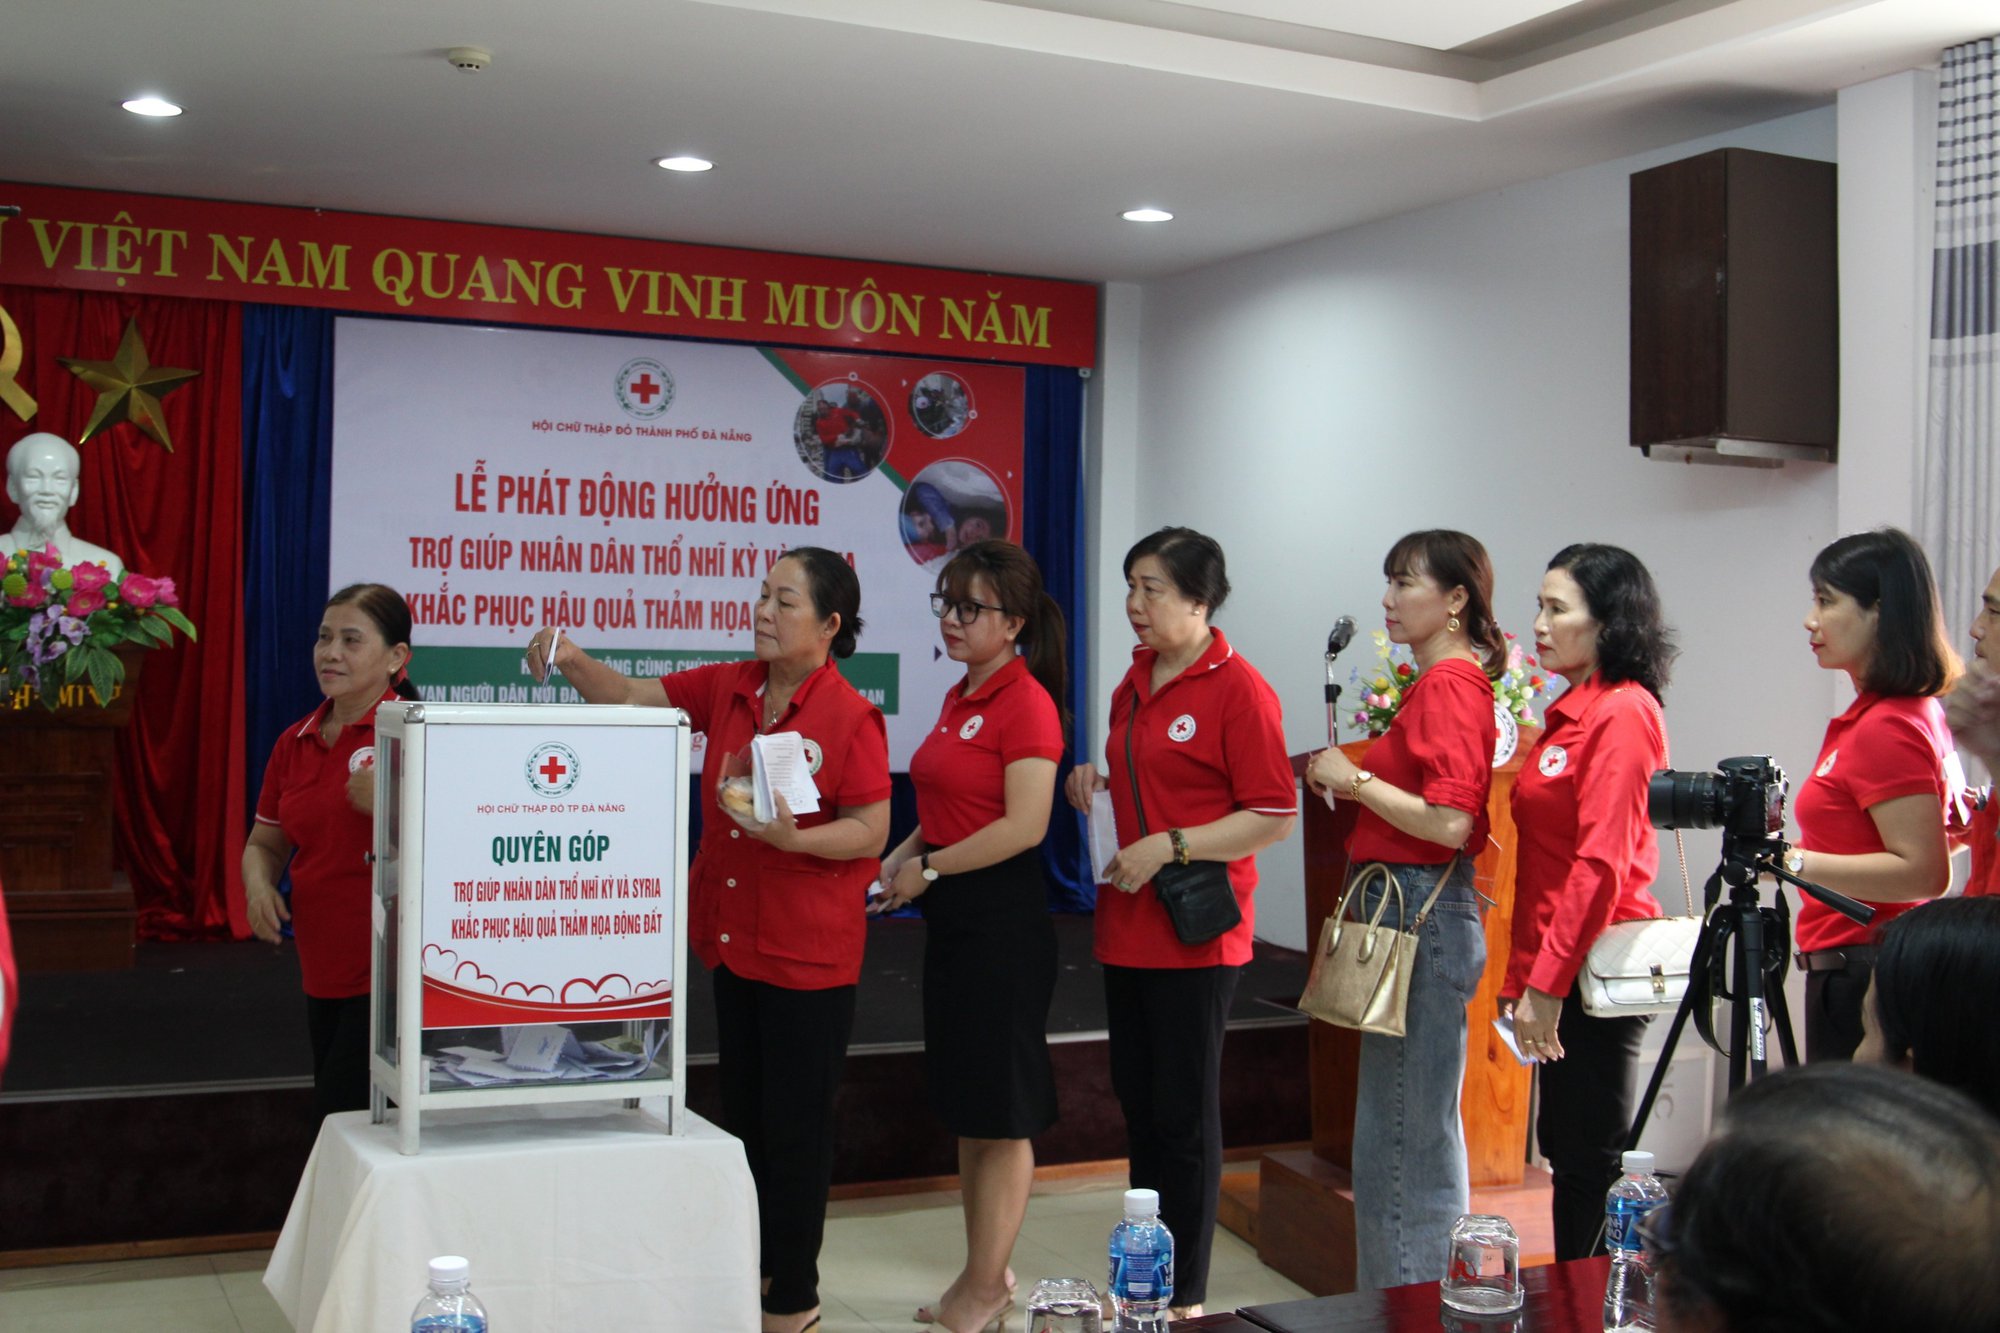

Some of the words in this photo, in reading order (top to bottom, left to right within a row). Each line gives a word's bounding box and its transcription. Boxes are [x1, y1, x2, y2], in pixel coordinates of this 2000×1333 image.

[27, 211, 188, 287] VIỆT
[206, 233, 352, 292] NAM
[372, 248, 588, 310] QUANG
[603, 267, 748, 322] VINH
[763, 278, 925, 337] MUÔN
[938, 290, 1053, 348] NĂM
[531, 419, 553, 434] HỘI
[556, 420, 582, 434] CHỮ
[584, 422, 613, 437] THẬP
[615, 423, 632, 436] ĐỎ
[636, 425, 673, 438] THÀNH
[676, 427, 700, 439] PHỐ
[702, 429, 718, 441] ĐÀ
[455, 459, 487, 513] LỄ
[497, 469, 571, 516] PHÁT
[578, 471, 656, 527] ĐỘNG
[665, 471, 757, 524] HƯỞNG
[766, 480, 819, 526] ỨNG
[409, 534, 453, 576] TRỢ
[460, 533, 513, 571] GIÚP
[520, 535, 583, 573] NHÂN
[590, 537, 635, 574] DÂN
[642, 534, 683, 576] THỔ
[689, 541, 726, 577] NHĨ
[732, 541, 759, 578] KỲ
[405, 582, 466, 625] KHẮC
[474, 595, 534, 633] PHỤC
[542, 590, 586, 634] HẬU
[593, 588, 637, 632] QUẢ
[644, 589, 703, 630] THẢM
[710, 601, 752, 637] HỌA
[636, 656, 672, 676] CÙNG
[450, 681, 495, 703] NGƯỜI
[498, 682, 529, 703] DÂN
[567, 804, 579, 813] TP
[492, 830, 561, 866] QUYÊN
[569, 829, 610, 862] GÓP
[453, 880, 473, 907] TRỢ
[476, 877, 500, 902] GIÚP
[503, 876, 532, 901] NHÂN
[535, 876, 556, 901] DÂN
[559, 871, 578, 900] THỔ
[581, 875, 599, 900] NHĨ
[601, 874, 614, 900] KỲ
[617, 874, 630, 899] VÀ
[632, 877, 661, 899] SYRIA
[452, 910, 479, 940] KHẮC
[482, 917, 510, 943] PHỤC
[513, 913, 534, 943] HẬU
[537, 909, 557, 939] QUẢ
[560, 908, 588, 937] THẢM
[591, 915, 611, 940] HỌA
[614, 910, 641, 940] ĐỘNG
[644, 906, 662, 935] ĐẤT
